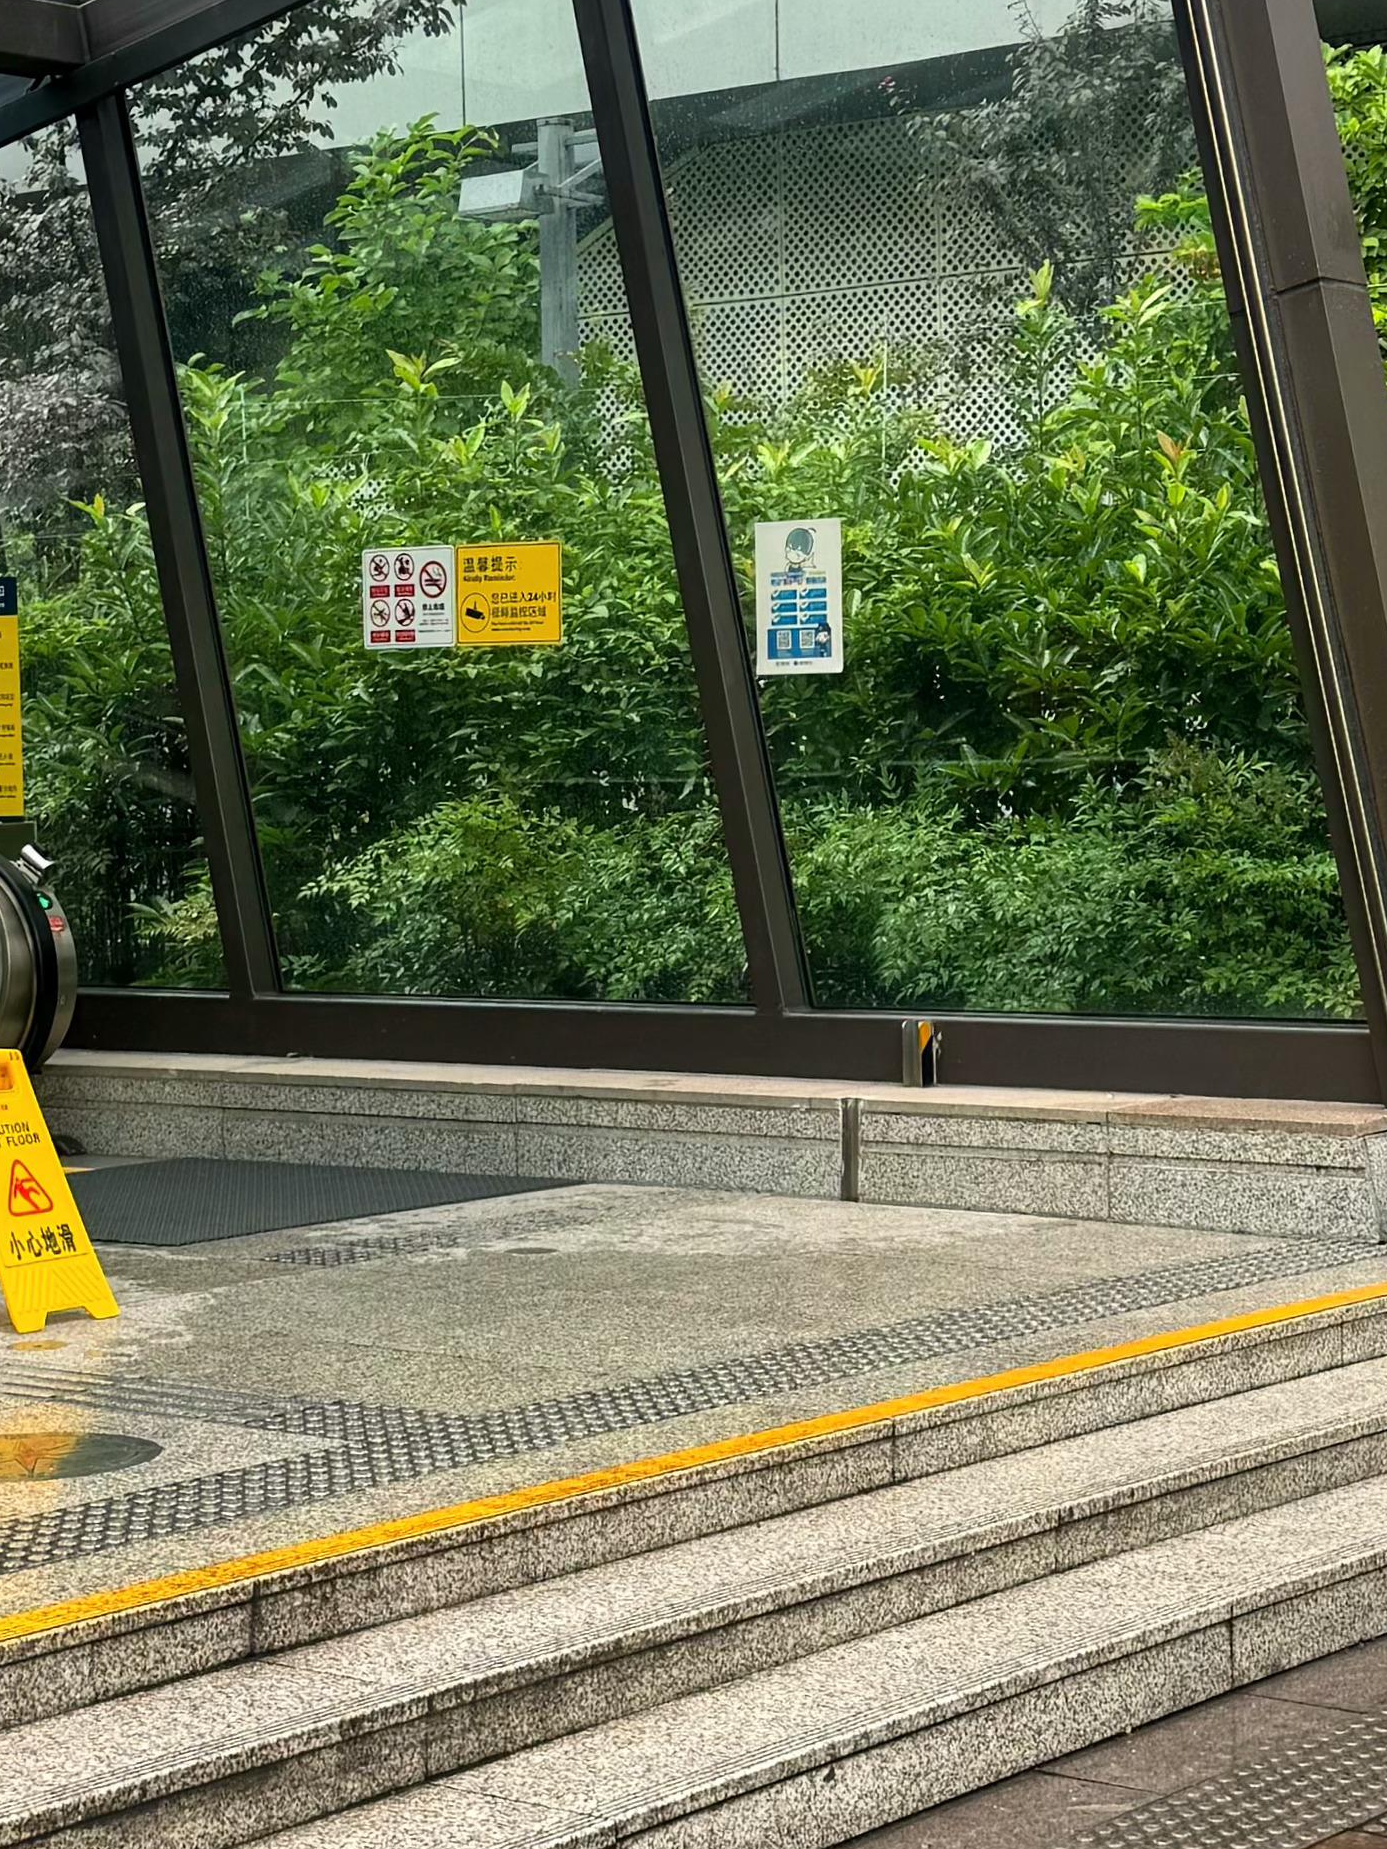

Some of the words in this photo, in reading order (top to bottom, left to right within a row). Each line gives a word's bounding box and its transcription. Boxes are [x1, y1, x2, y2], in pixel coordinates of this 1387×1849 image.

[7, 1133, 41, 1148] FLOOR
[10, 1223, 77, 1261] 小心地滑
